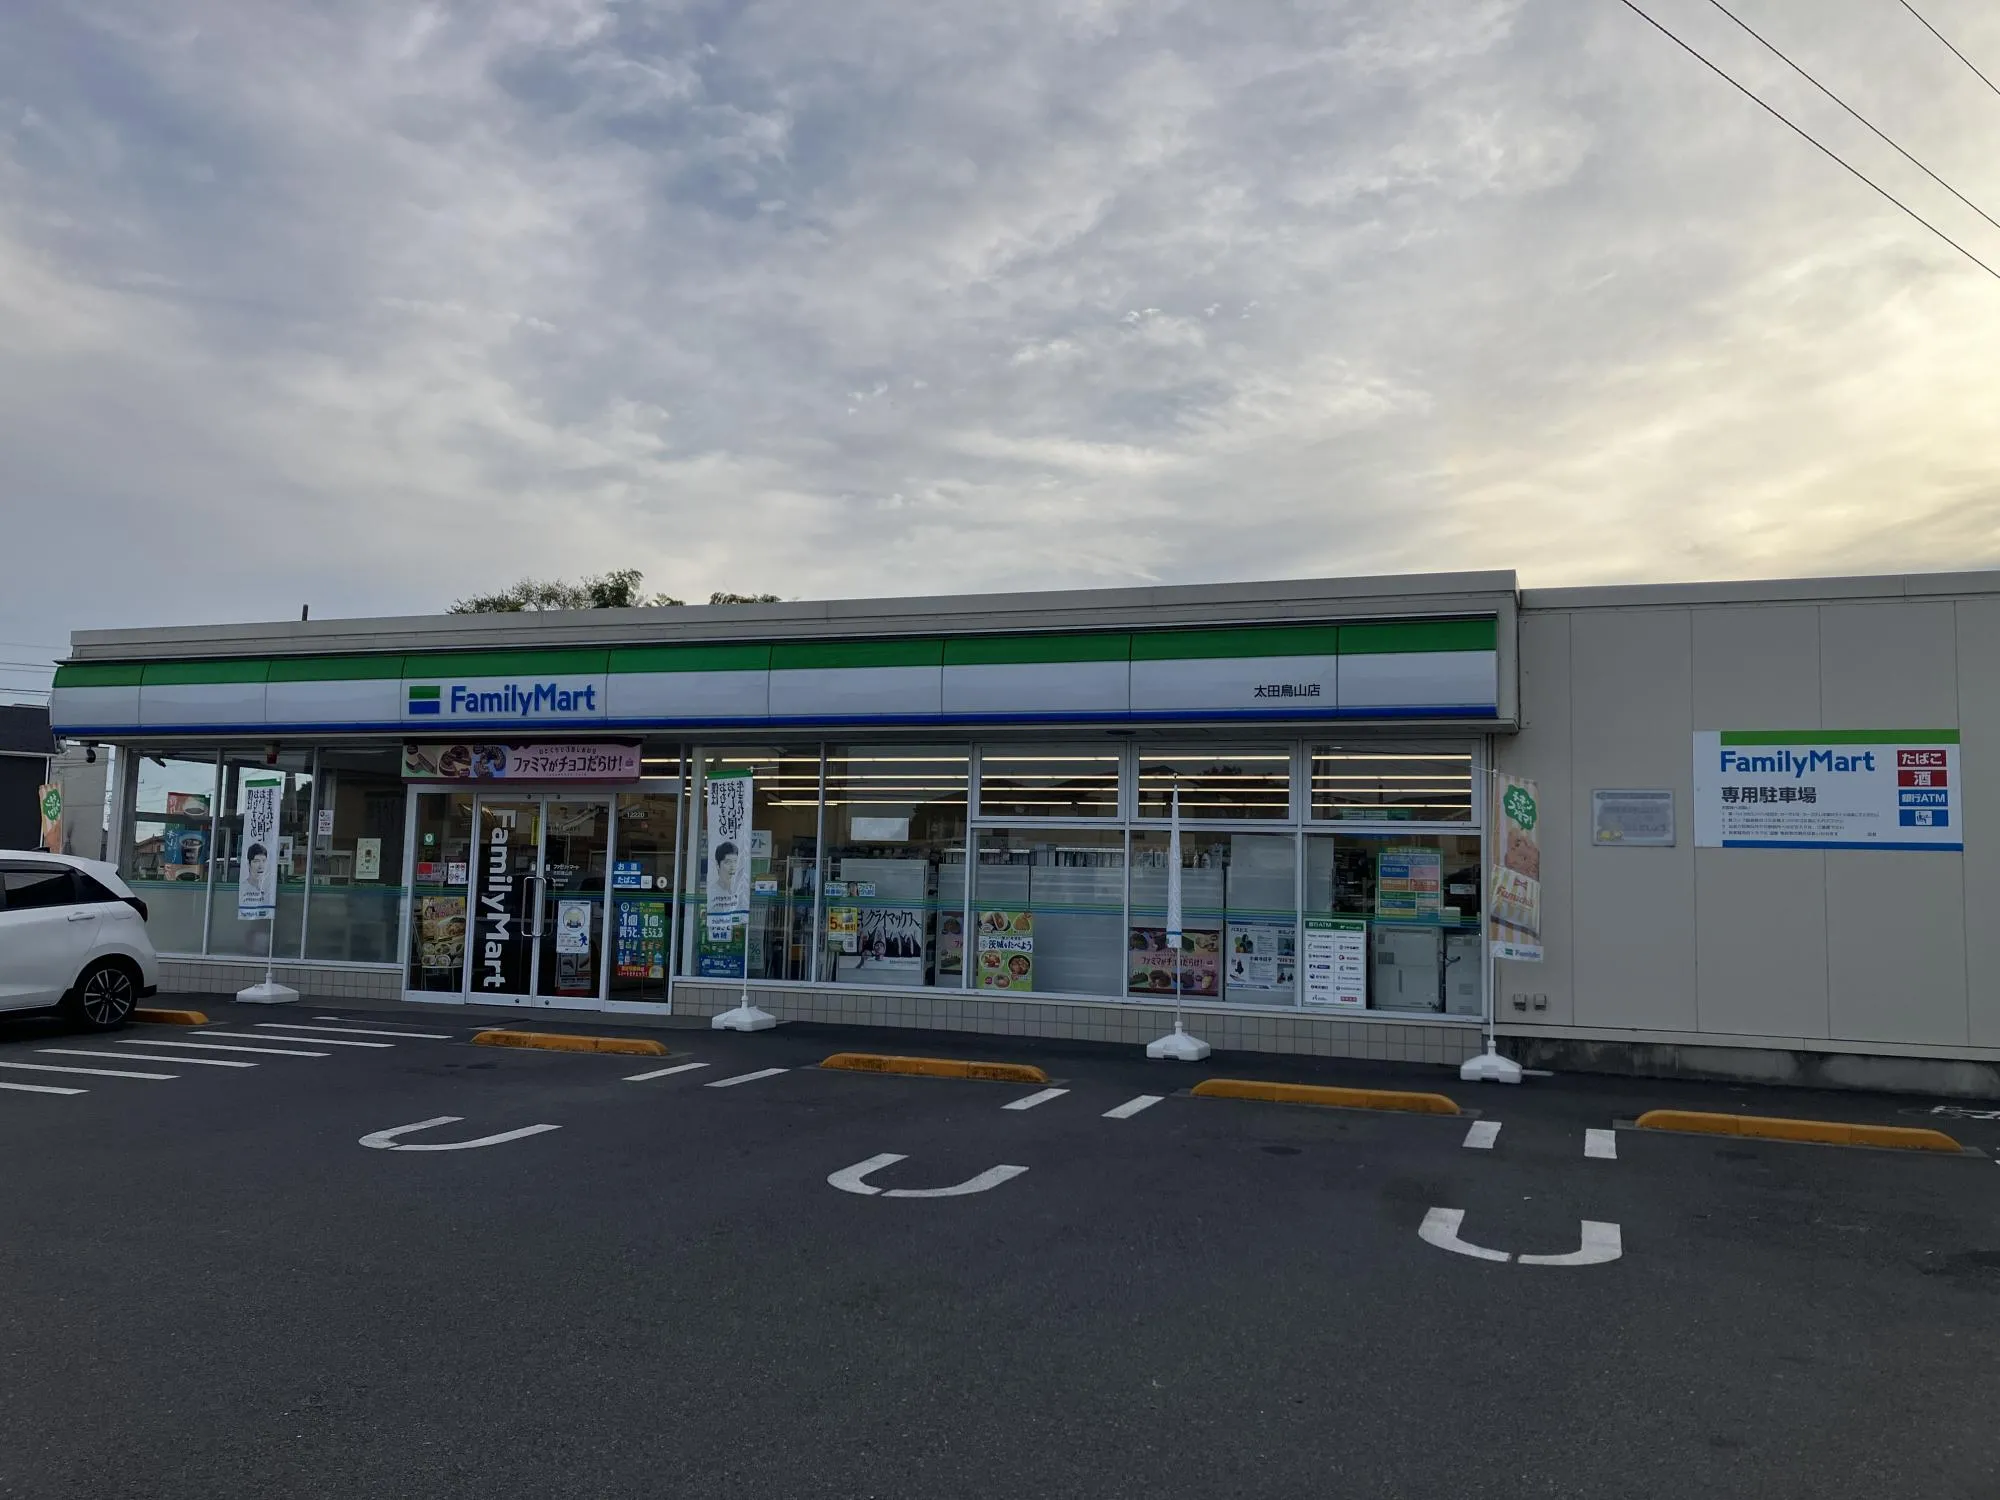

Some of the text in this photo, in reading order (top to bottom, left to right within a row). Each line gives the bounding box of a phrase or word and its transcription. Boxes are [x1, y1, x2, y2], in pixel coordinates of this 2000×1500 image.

[1254, 683, 1321, 698] 太田鳥山店
[451, 683, 595, 716] FamilyMart
[1720, 750, 1875, 777] FamilyMart
[1900, 752, 1943, 766] たばこ
[1912, 770, 1932, 786] 酒
[1721, 786, 1818, 804] 専用駐車場
[1901, 793, 1946, 804] 銀行ATM
[617, 875, 637, 884] たばこ
[481, 809, 516, 988] FamilyMart
